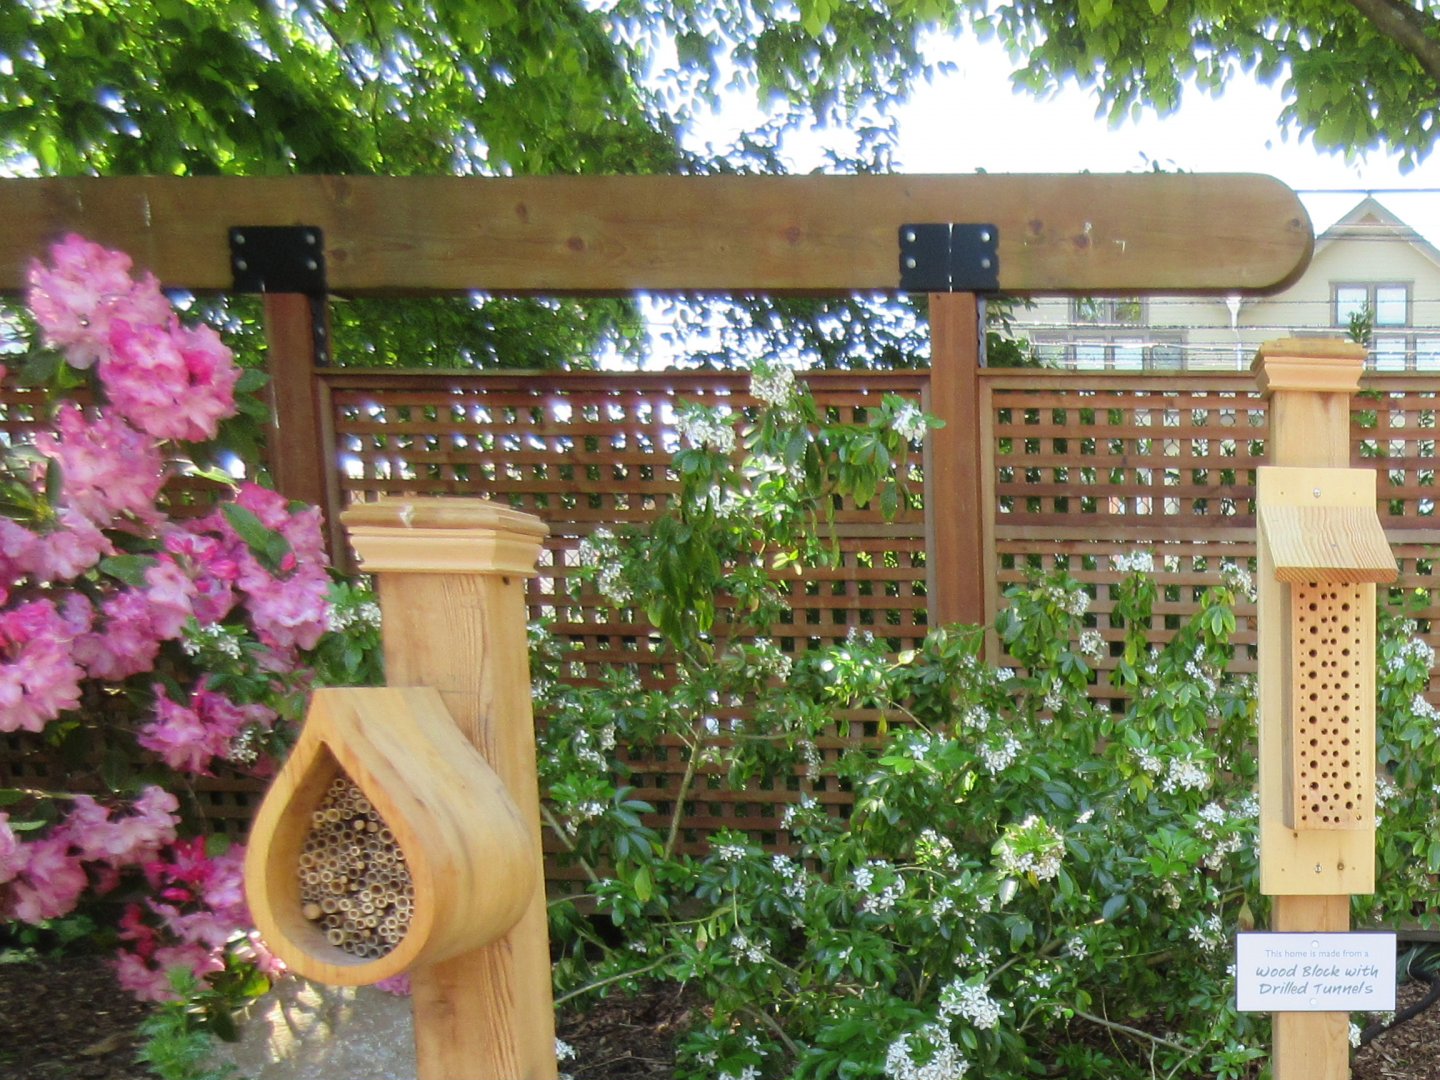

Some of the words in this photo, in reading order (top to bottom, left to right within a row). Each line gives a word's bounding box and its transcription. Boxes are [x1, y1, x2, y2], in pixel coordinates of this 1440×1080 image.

[1285, 949, 1307, 957] home
[1311, 949, 1316, 957] is
[1319, 949, 1340, 957] made
[1343, 949, 1361, 957] from
[1256, 964, 1297, 977] Wood
[1302, 965, 1340, 977] Block
[1345, 965, 1379, 978] with
[1259, 981, 1307, 995] Drilled
[1313, 982, 1373, 995] Tunnels
